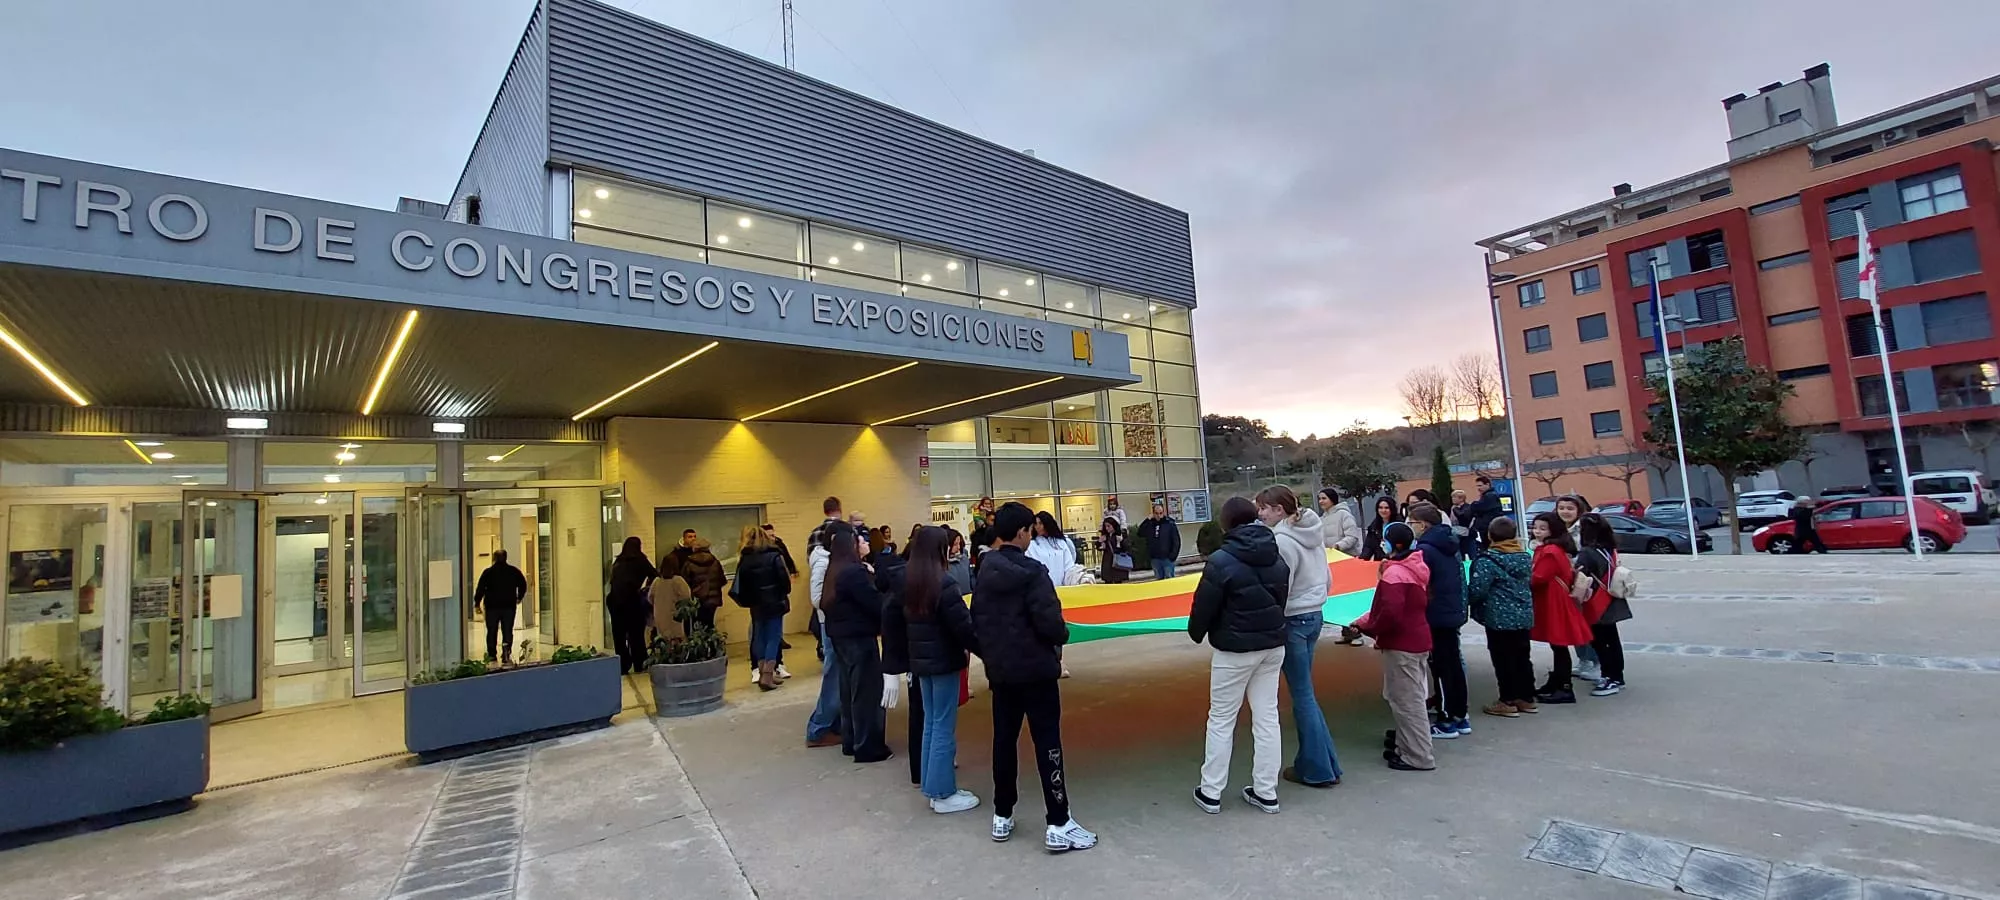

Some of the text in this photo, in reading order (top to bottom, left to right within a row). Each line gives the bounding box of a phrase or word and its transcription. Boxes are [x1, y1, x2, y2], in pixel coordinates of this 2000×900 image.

[1, 168, 1046, 353] TRO DE CONGRESOS Y EXPOSICIONES
